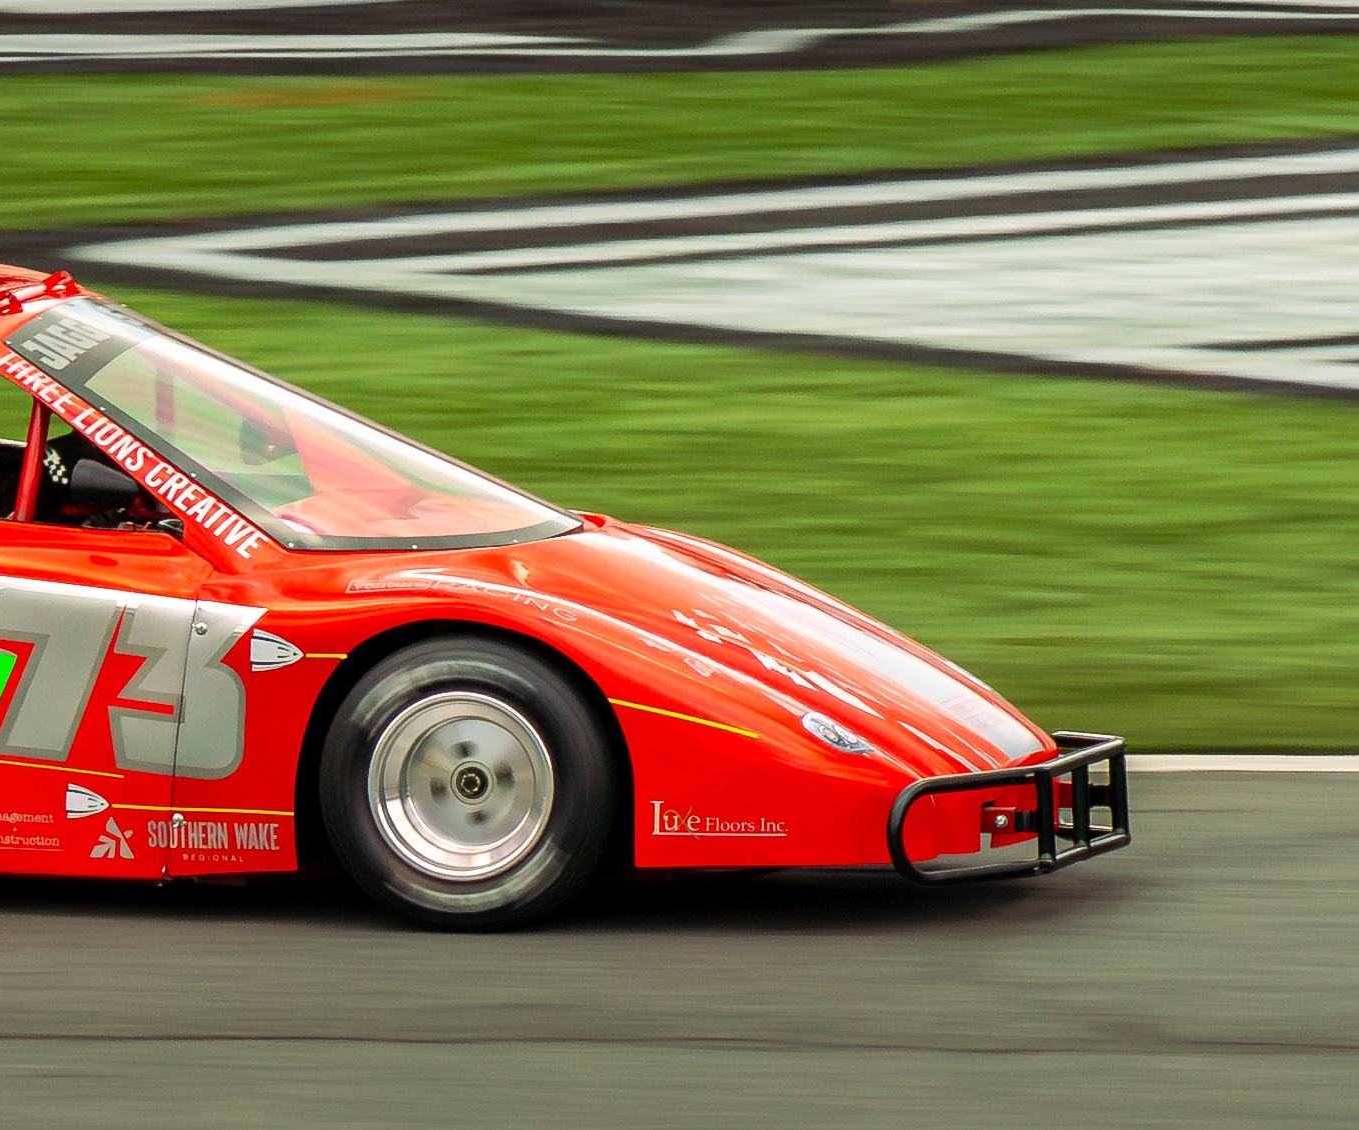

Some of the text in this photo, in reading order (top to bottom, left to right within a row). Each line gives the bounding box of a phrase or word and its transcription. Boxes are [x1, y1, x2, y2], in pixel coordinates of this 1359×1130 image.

[21, 319, 111, 371] JAGG
[72, 408, 155, 472] LIONS
[144, 462, 270, 560] CREATIVE
[147, 820, 280, 850] SOUTHERN WAKE
[705, 817, 755, 832] Floors
[760, 817, 789, 832] Inc.
[182, 853, 244, 863] REGIONAL
